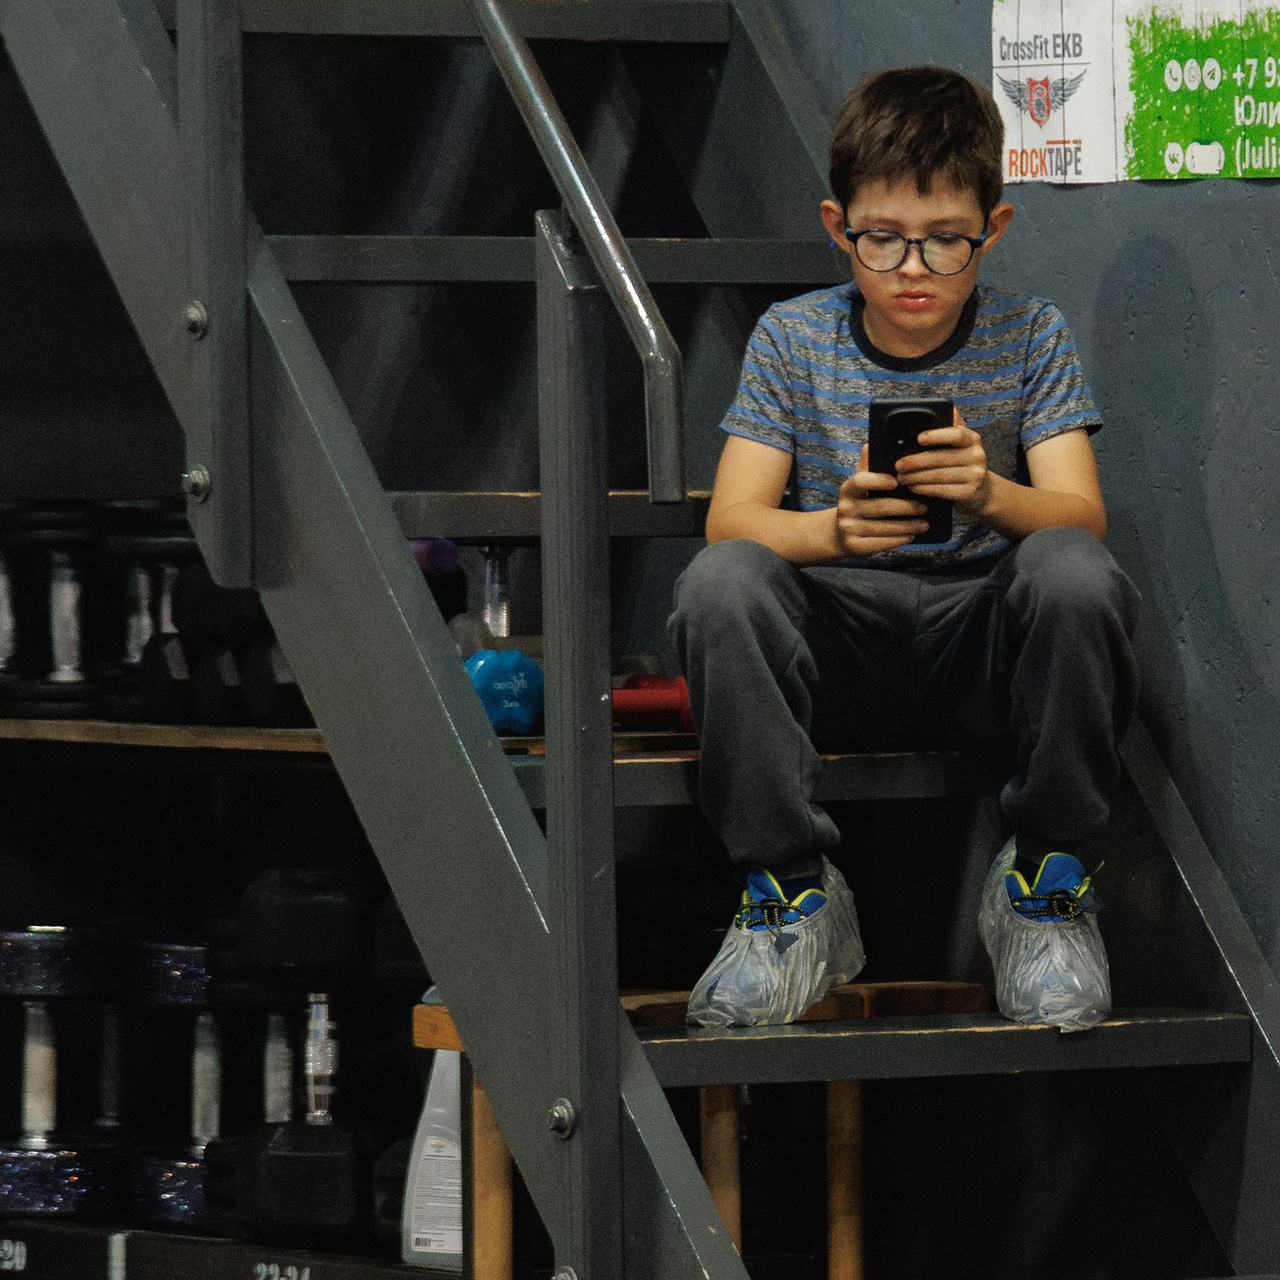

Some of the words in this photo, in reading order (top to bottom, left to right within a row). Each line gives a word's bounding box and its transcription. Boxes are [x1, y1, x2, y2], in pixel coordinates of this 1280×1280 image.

[1000, 34, 1049, 61] CrossFit
[1052, 32, 1083, 58] EKB
[1233, 58, 1258, 89] +7
[1008, 147, 1082, 178] ROCKTAPE
